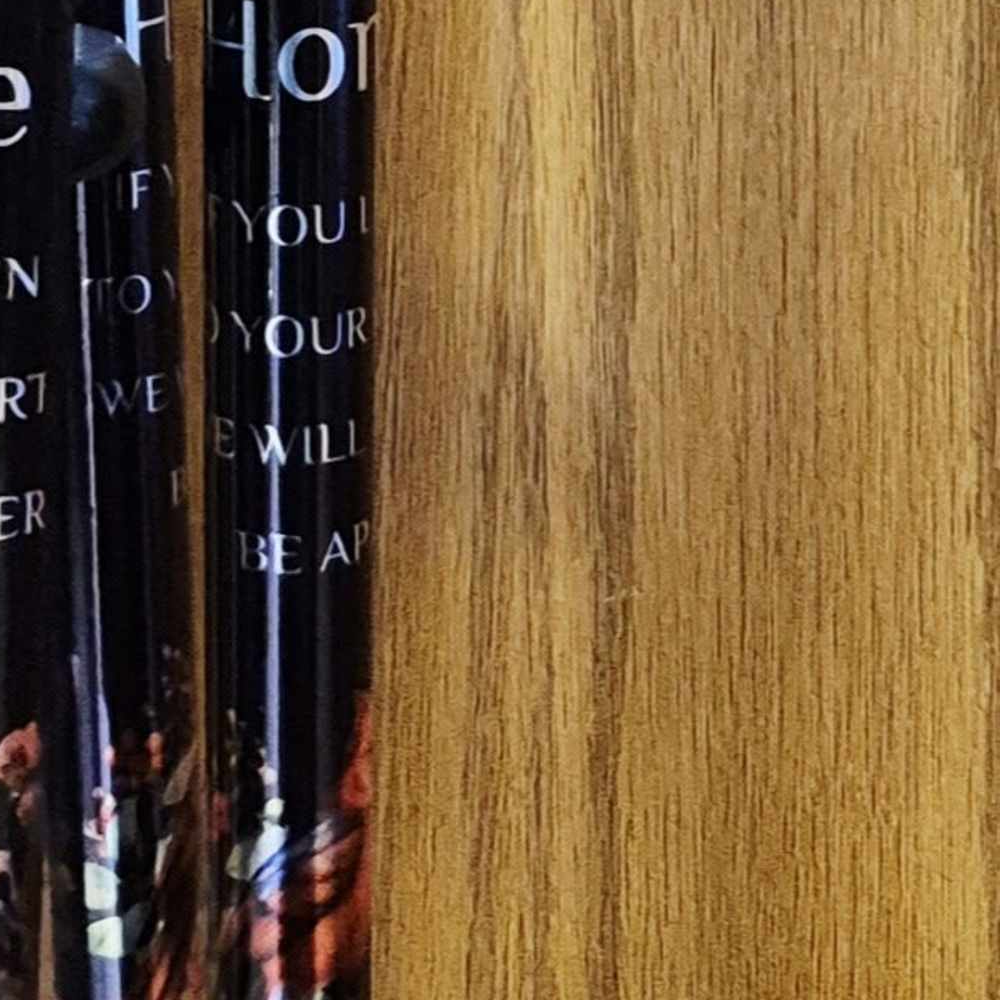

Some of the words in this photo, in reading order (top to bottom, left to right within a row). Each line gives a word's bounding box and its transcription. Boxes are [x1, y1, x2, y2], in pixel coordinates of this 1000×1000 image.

[229, 305, 368, 358] YOUR
[250, 418, 366, 467] WILL
[236, 528, 303, 577] BE
